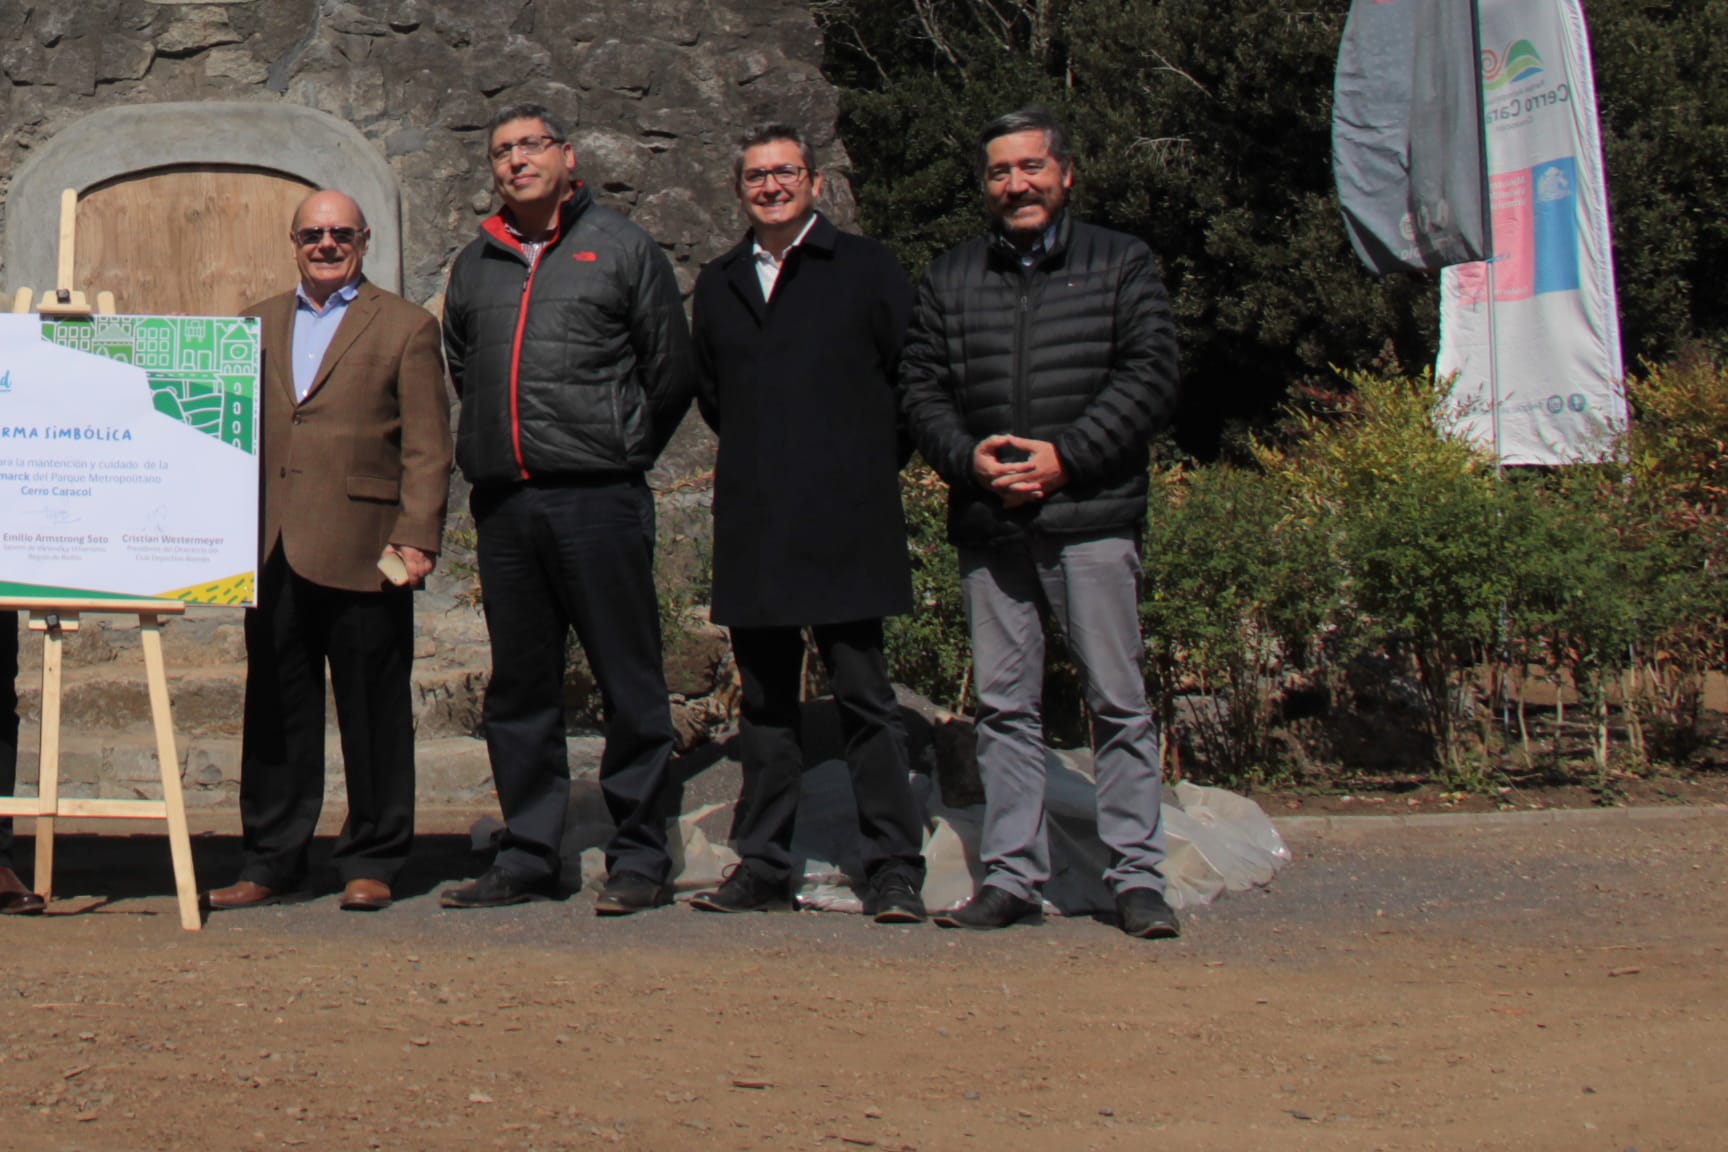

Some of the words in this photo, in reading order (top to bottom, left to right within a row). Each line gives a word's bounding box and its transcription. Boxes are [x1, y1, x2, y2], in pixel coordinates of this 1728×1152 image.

[15, 458, 25, 467] la
[89, 460, 96, 470] y
[98, 459, 139, 469] cuidado
[144, 460, 156, 469] de
[159, 460, 169, 470] la
[32, 472, 49, 481] del
[51, 472, 86, 484] Parque
[88, 473, 162, 485] Metropolitano
[21, 486, 49, 496] Cerro
[51, 486, 92, 497] Caracol
[3, 533, 33, 543] Emilio
[35, 534, 85, 545] Armstrong
[87, 535, 109, 544] Soto
[122, 534, 159, 543] Cristian
[161, 535, 224, 546] Westermeyer
